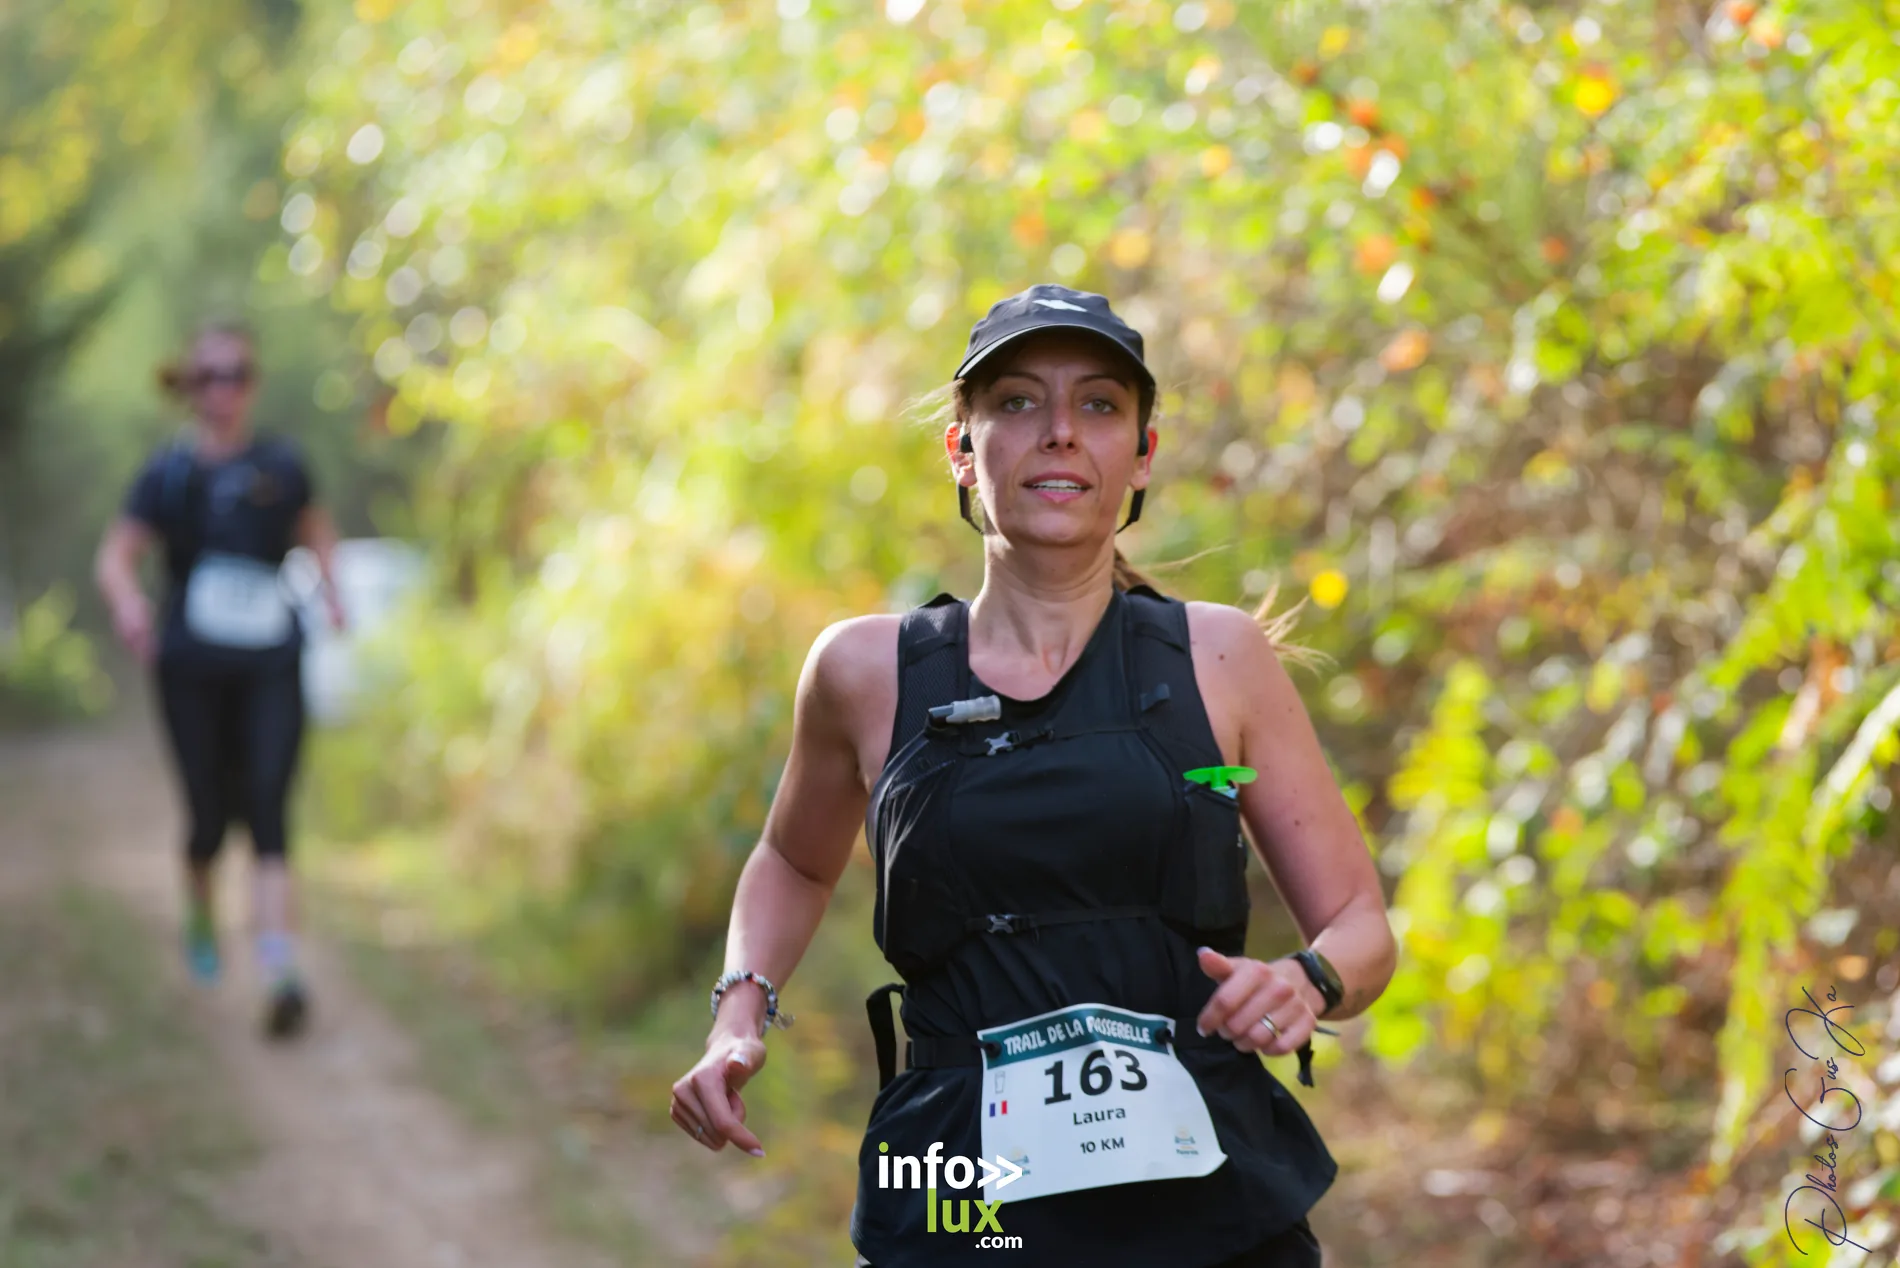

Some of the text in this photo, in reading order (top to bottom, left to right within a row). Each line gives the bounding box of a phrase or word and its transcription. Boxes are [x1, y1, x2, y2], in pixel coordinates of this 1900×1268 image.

[1004, 1031, 1046, 1056] TRAIL
[1048, 1023, 1066, 1044] DE
[1067, 1019, 1084, 1039] LA
[1044, 1050, 1148, 1105] 163
[1073, 1107, 1126, 1126] Laura
[1080, 1136, 1125, 1154] 10 KM
